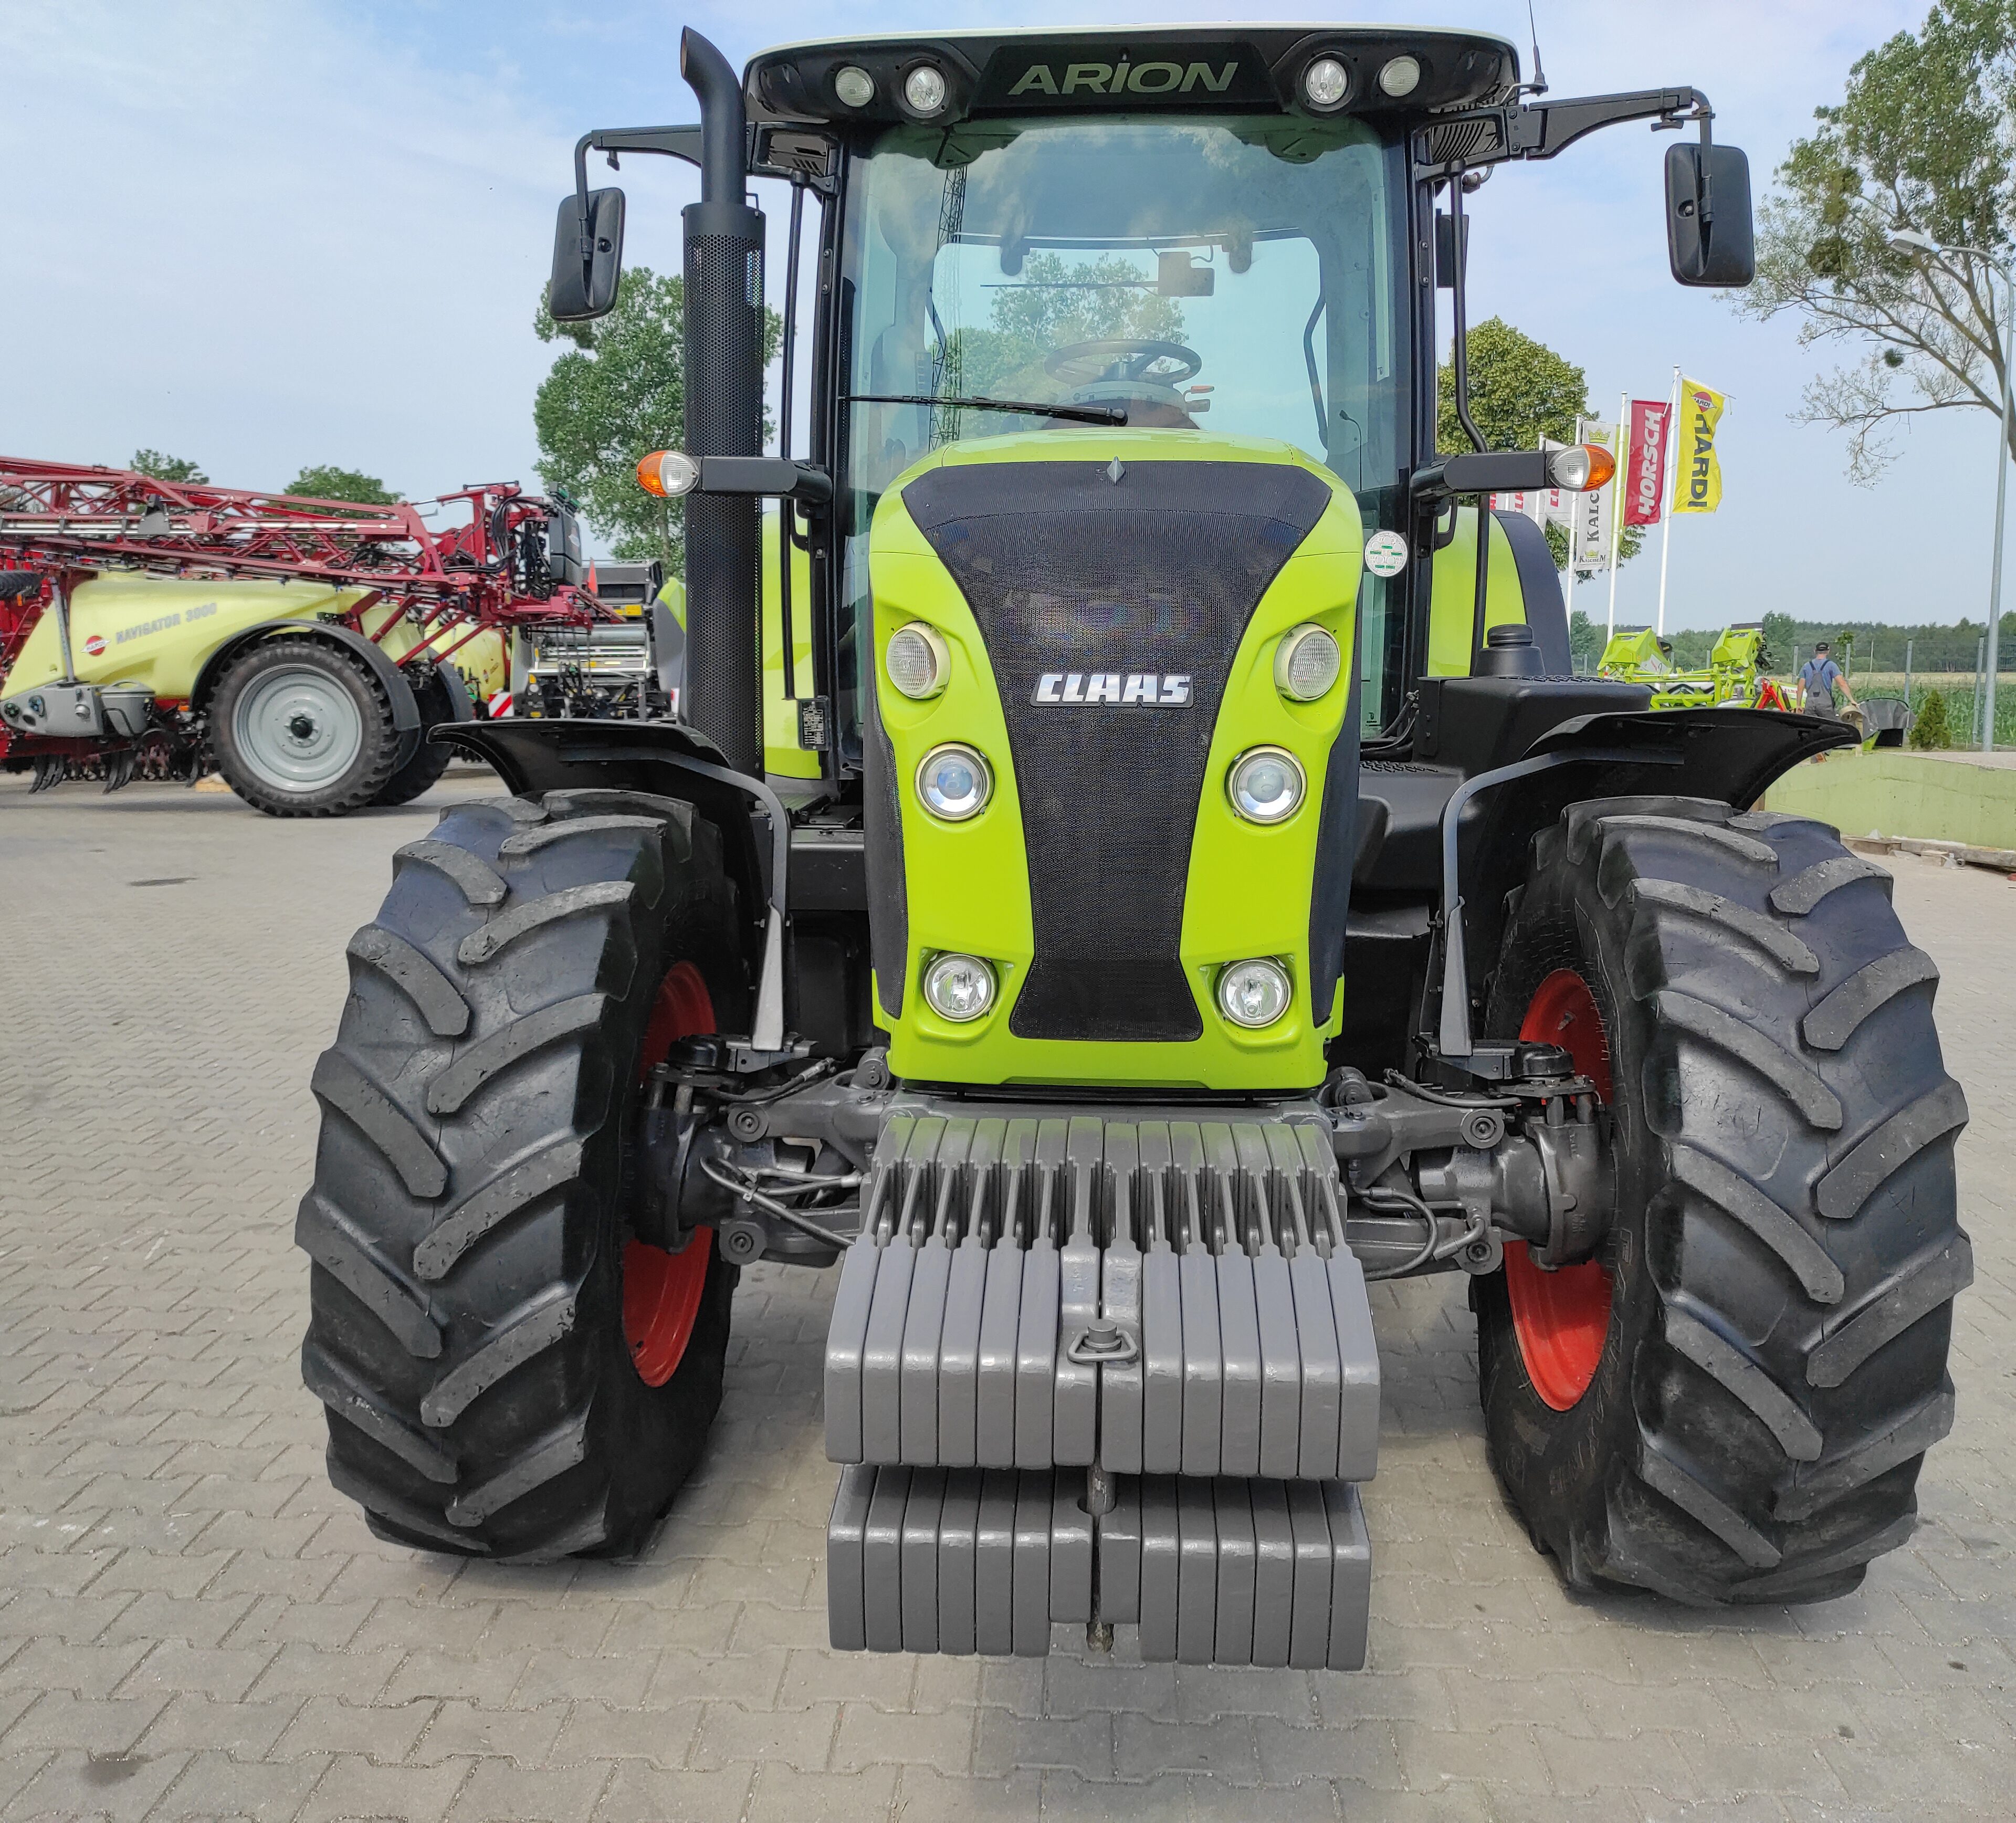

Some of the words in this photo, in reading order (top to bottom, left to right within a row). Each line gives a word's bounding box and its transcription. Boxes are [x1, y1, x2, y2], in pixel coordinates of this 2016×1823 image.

[1007, 62, 1238, 95] ARION
[1694, 398, 1711, 408] ARDI
[1638, 408, 1662, 517] HORSCH
[1687, 413, 1712, 508] HARDI
[116, 613, 181, 645] NAVIGATOR
[185, 603, 217, 622] 3000
[1036, 674, 1191, 704] CLAAS
